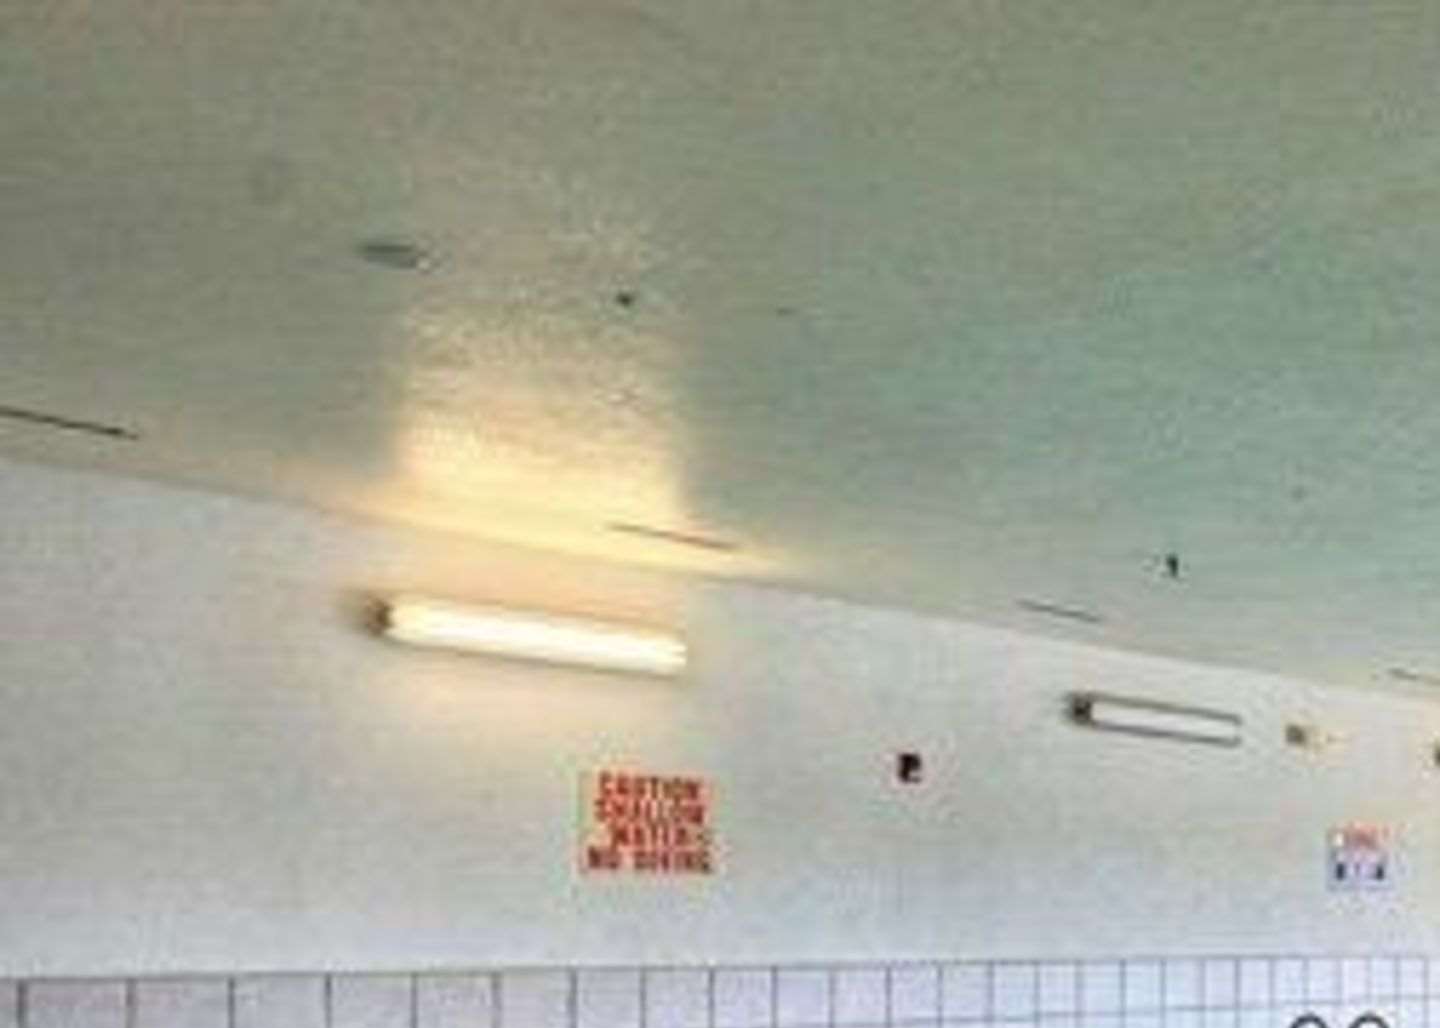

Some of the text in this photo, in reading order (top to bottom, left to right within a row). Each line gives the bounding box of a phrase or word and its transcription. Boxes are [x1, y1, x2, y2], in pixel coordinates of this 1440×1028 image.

[598, 771, 700, 801] CAUTION
[595, 798, 704, 826] SHALLOW
[588, 846, 713, 875] NO DIVING
